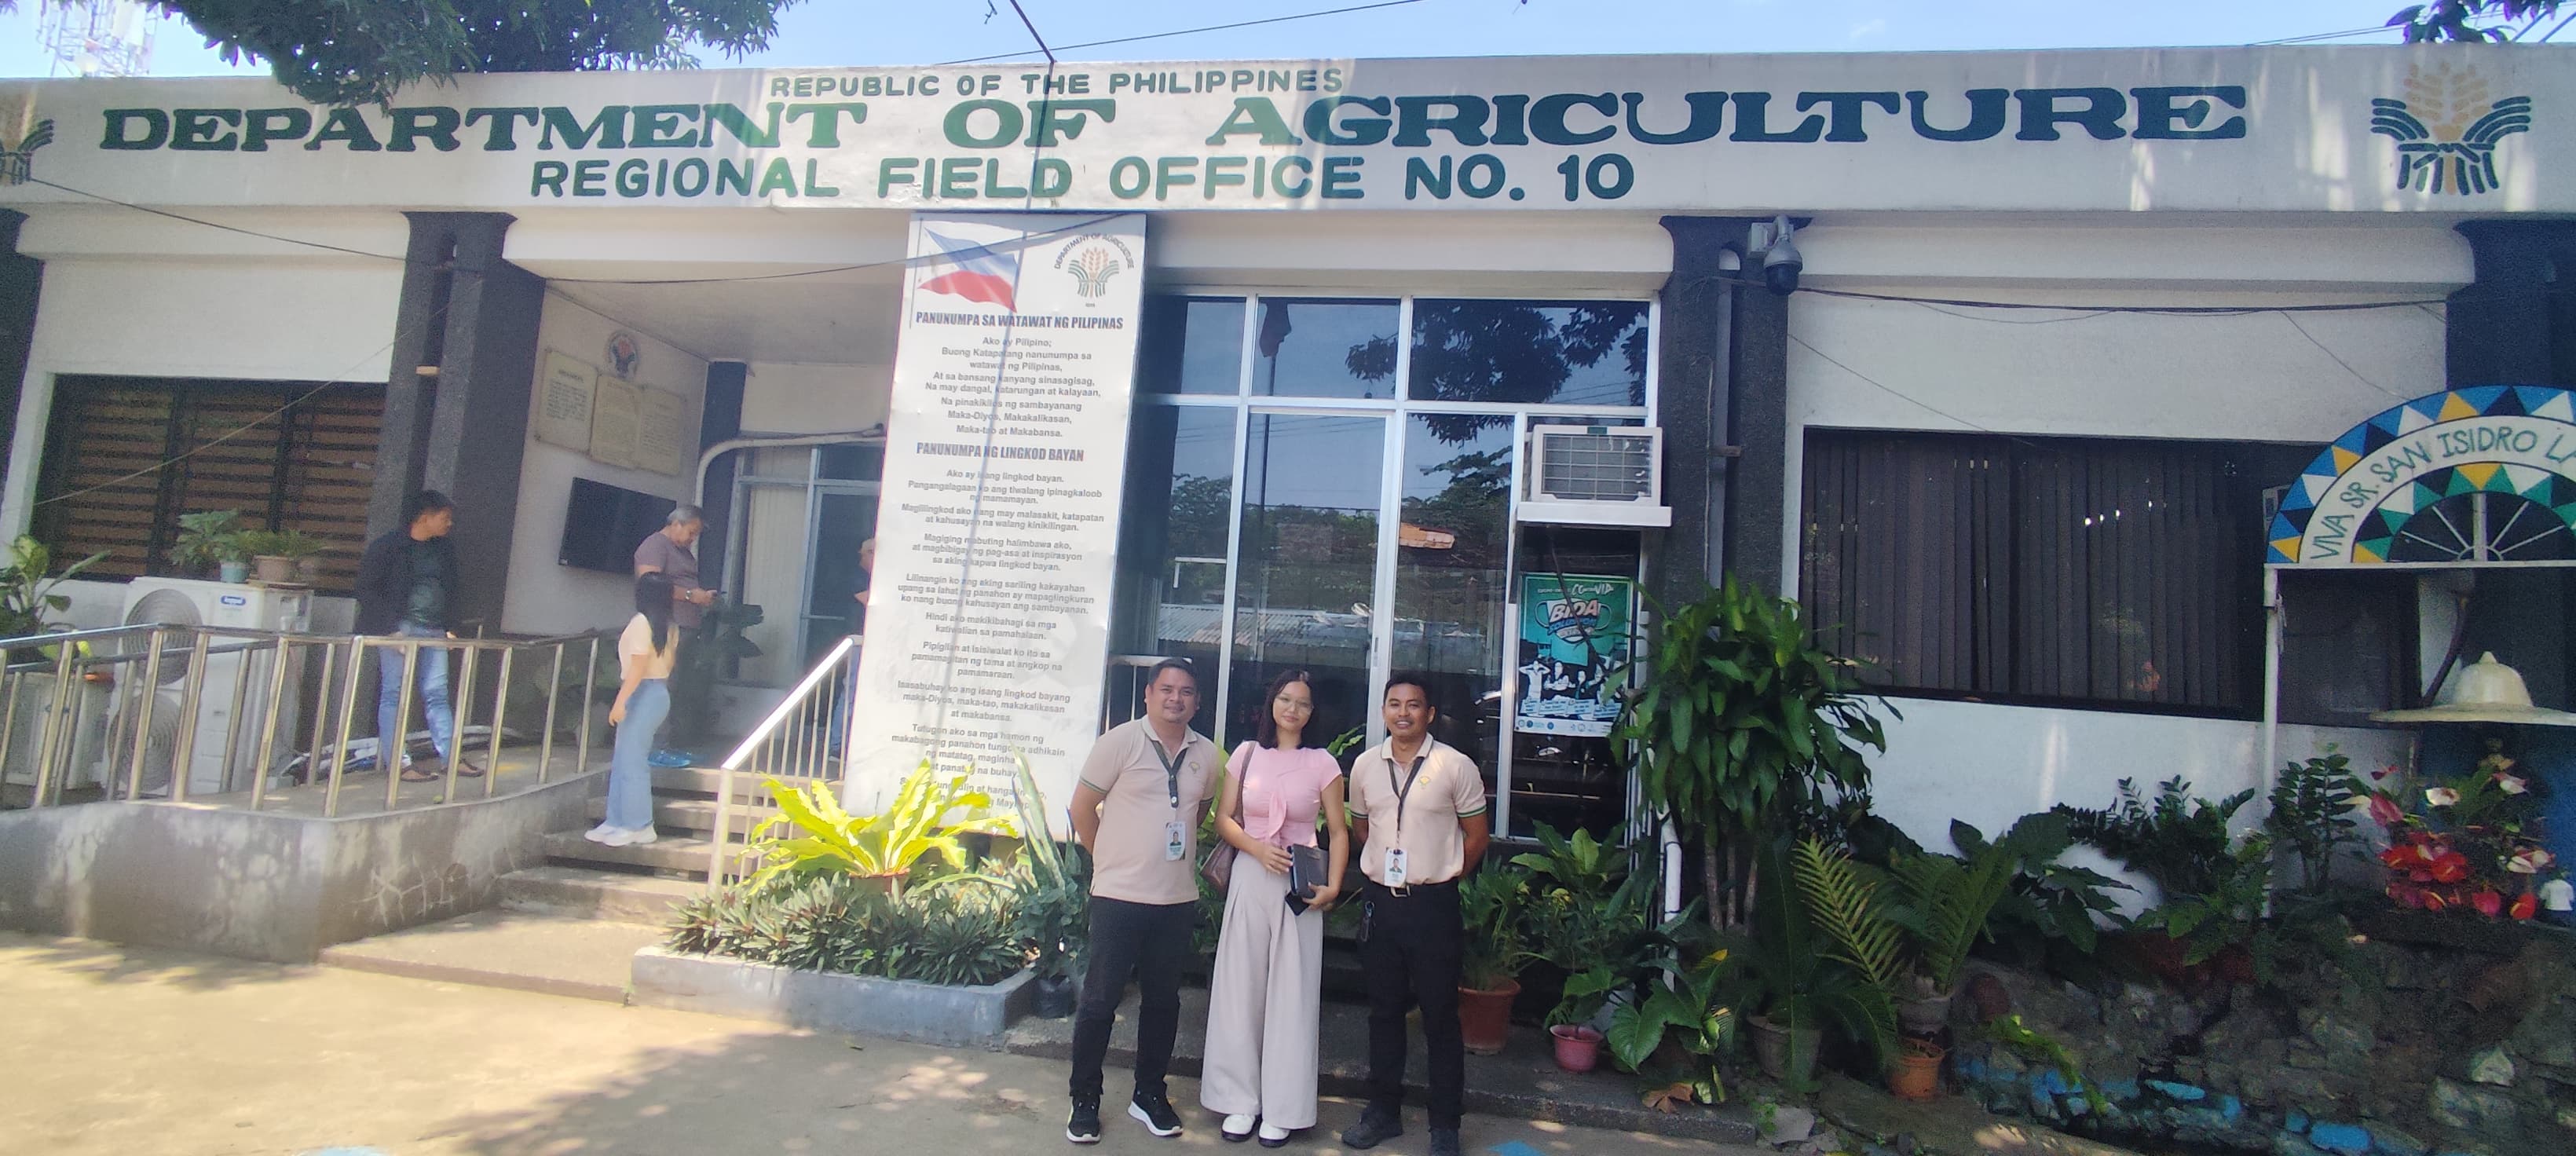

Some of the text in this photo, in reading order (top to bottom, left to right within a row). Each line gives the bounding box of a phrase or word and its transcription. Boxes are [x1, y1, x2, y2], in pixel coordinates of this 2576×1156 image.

[770, 68, 1343, 97] REPUBLIC OF THE PHILIPPINES
[101, 86, 2246, 151] DEPARTMENT OF AGRICULTURE
[529, 152, 1636, 202] REGIONAL FIELD OFFICE NO. 10
[1054, 234, 1089, 269] DEPARTMENT
[916, 312, 1123, 330] PANUNUMPA SA WATAWAT NG PILIPINAS
[982, 336, 1000, 345] Ako
[942, 346, 971, 357] Buong
[1026, 352, 1078, 361] nanunumpa
[1008, 363, 1019, 371] ng
[933, 371, 942, 380] At
[957, 372, 996, 383] bansang
[925, 382, 937, 390] Na
[939, 384, 957, 393] may
[941, 397, 953, 405] Na
[1019, 401, 1081, 412] sambayanang
[917, 442, 1084, 462] PANUNUMPA NG LINGKOD BAYAN
[946, 469, 963, 477] Ako
[965, 472, 975, 481] ay
[1002, 471, 1034, 482] lingkod
[991, 486, 1007, 495] ang
[2311, 514, 2355, 560] VIVA
[2340, 481, 2380, 509] SR.
[2369, 441, 2431, 483] SAN
[2437, 426, 2538, 459] ISIDRO
[956, 507, 971, 515] ako
[997, 510, 1014, 519] may
[1062, 511, 1103, 523] katapatan
[995, 519, 1026, 530] walang
[924, 532, 962, 545] Magiging
[1006, 537, 1051, 548] halimbawa
[986, 548, 1019, 558] pag-asa
[944, 556, 967, 567] aking
[998, 559, 1030, 570] lingkod
[949, 576, 959, 584] ko
[979, 578, 1002, 589] aking
[1005, 580, 1037, 591] sariling
[1038, 581, 1085, 592] kakayahan
[898, 585, 924, 594] upang
[937, 585, 958, 594] lahat
[973, 589, 1010, 598] panahon
[1012, 592, 1023, 601] ay
[901, 594, 911, 602] ko
[913, 596, 934, 605] nang
[936, 596, 963, 608] buong
[965, 598, 1011, 610] kahusayan
[1013, 602, 1029, 612] ang
[925, 612, 947, 621] Hindi
[1037, 621, 1056, 630] mga
[1013, 647, 1024, 657] ko
[1026, 648, 1038, 657] ito
[970, 658, 981, 667] ng
[983, 657, 1004, 666] tama
[1017, 660, 1049, 671] angkop
[960, 687, 975, 696] ang
[979, 686, 1001, 698] isang
[1004, 688, 1036, 699] lingkod
[1038, 690, 1070, 703] bayang
[949, 727, 964, 736] ako
[979, 731, 997, 740] mga
[1001, 730, 1030, 741] hamon
[1033, 735, 1043, 744] ng
[948, 740, 1065, 755] panahon adhikain
[990, 766, 1016, 778] buhay
